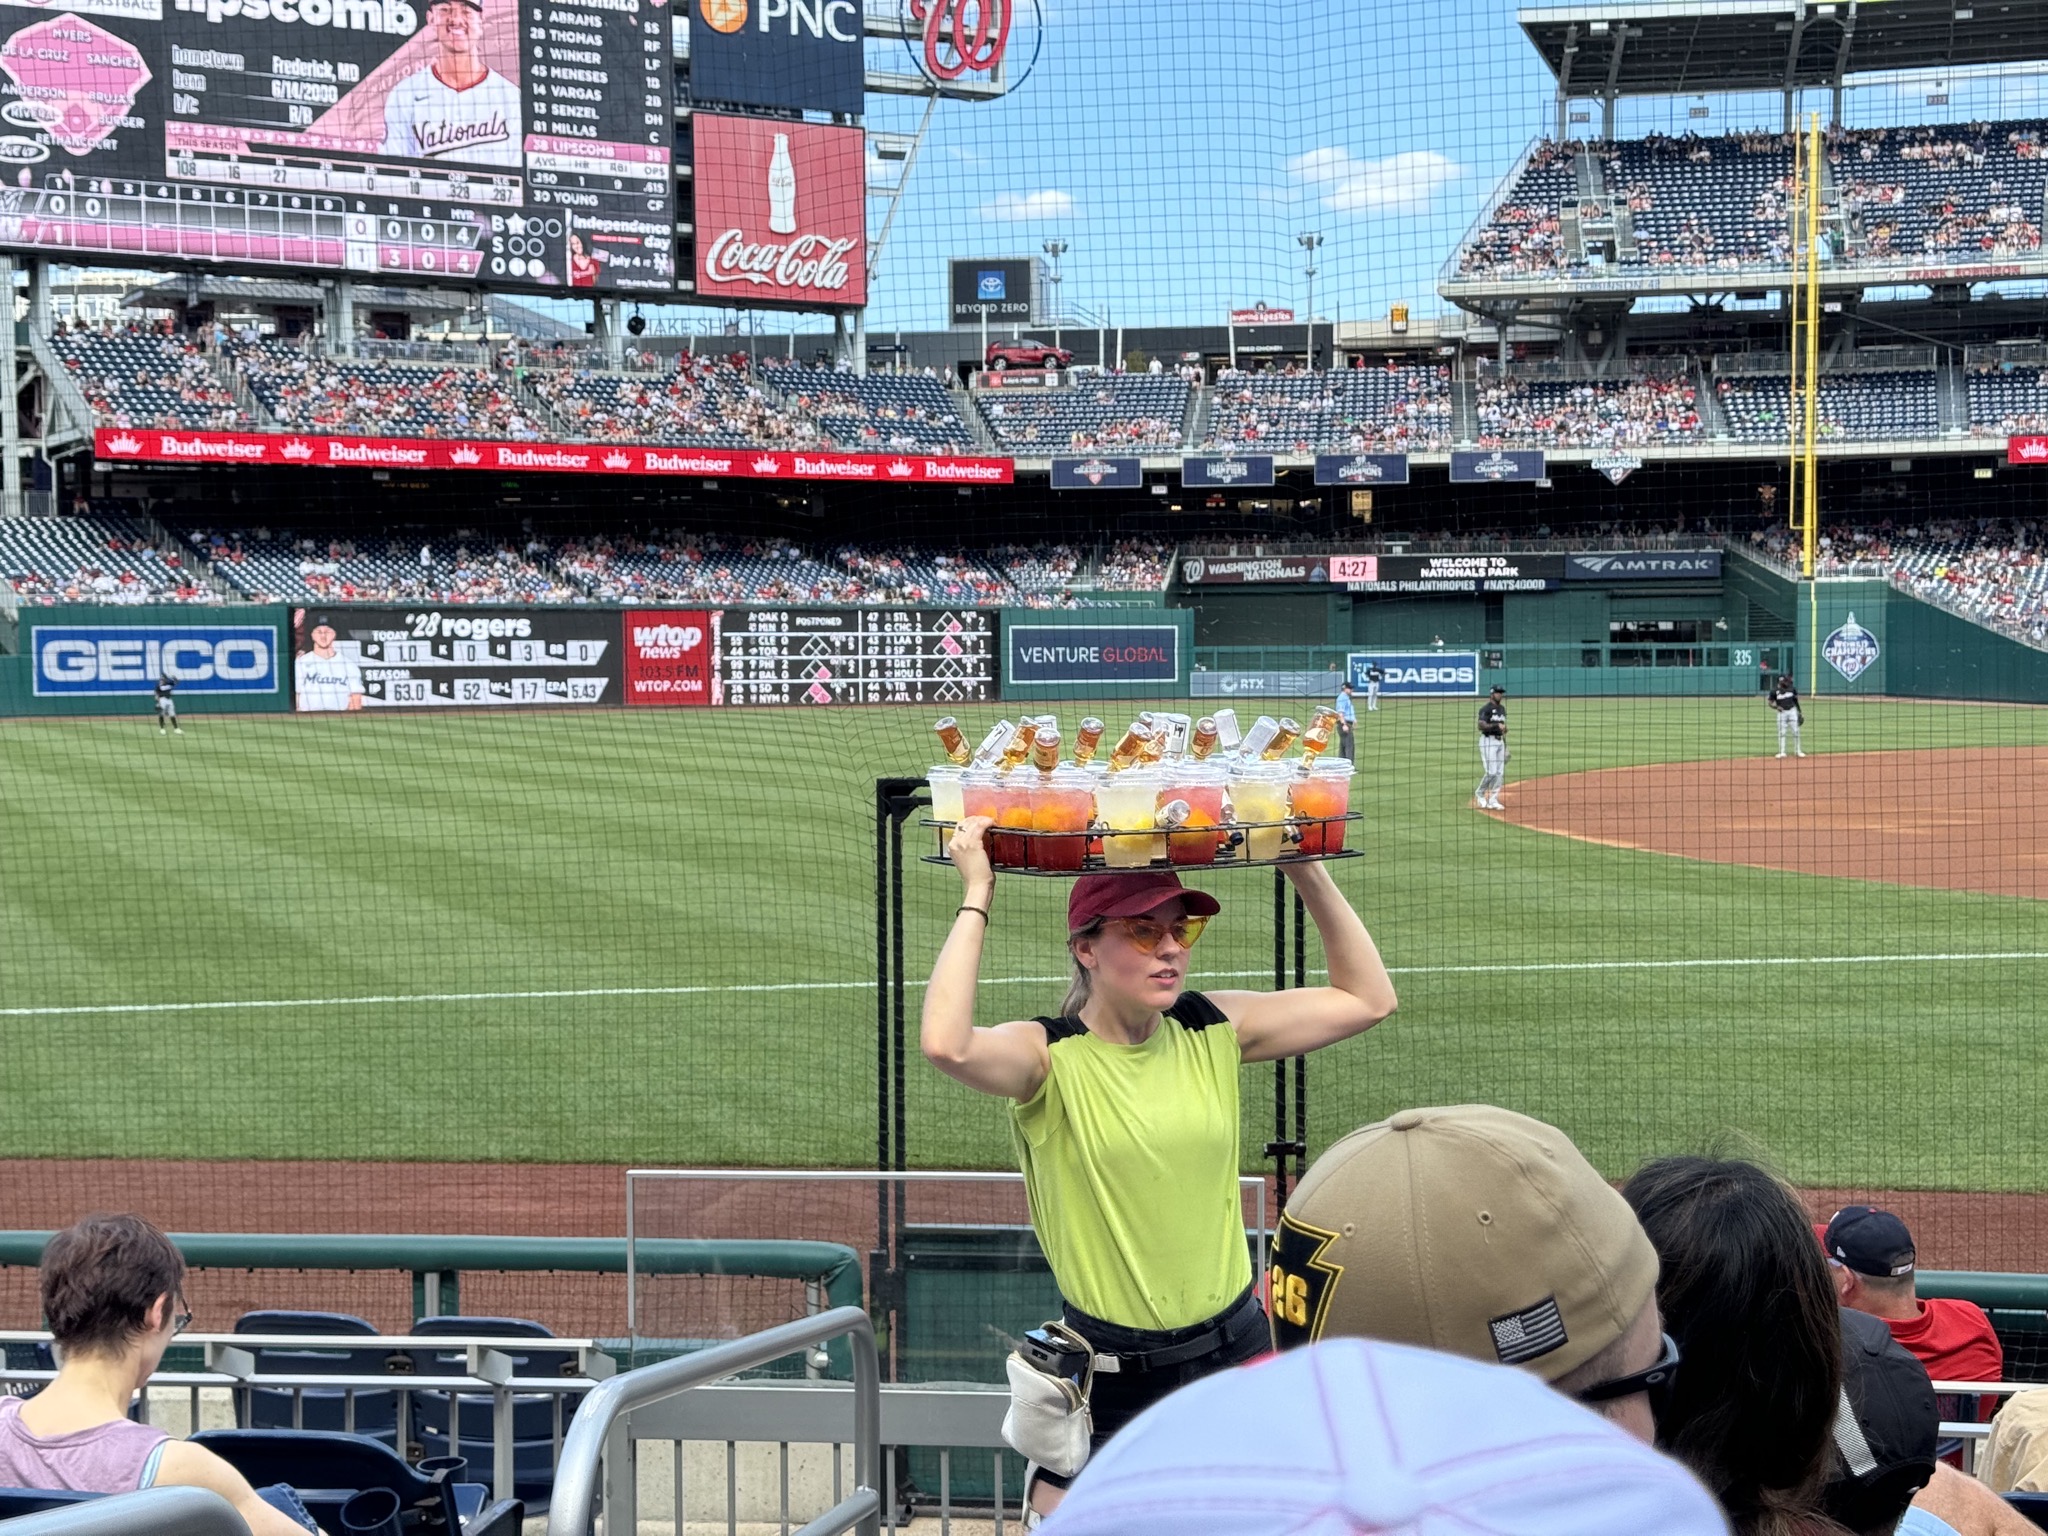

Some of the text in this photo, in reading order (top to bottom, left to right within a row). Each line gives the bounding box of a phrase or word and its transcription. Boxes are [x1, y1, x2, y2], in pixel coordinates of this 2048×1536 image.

[174, 0, 418, 37] pscomb
[549, 11, 660, 35] ABRAMS SS
[758, 0, 857, 42] PNC
[52, 29, 92, 43] MYERS
[530, 27, 661, 52] 28 THOMAS RF
[20, 47, 34, 58] LA
[38, 48, 70, 62] CRUZ
[86, 53, 140, 69] SANCHEZ
[533, 46, 661, 71] 6 WINKER LF
[172, 44, 244, 71] hometown
[272, 55, 336, 82] Frederick,
[337, 62, 360, 82] MD
[531, 64, 660, 89] 45 MENESES 1B
[1, 84, 66, 99] ANDERSON
[172, 69, 338, 104] born 6/14/2000
[533, 83, 662, 108] 14 VARGAS 2B
[533, 102, 663, 126] 13 SENZEL DH
[99, 115, 145, 129] BURGER
[412, 111, 510, 150] Nationals
[552, 122, 597, 138] MILLAS
[178, 138, 238, 150] THIS SEASON
[552, 140, 615, 157] LIPSCOMB
[534, 157, 665, 177] AVG HR RBI OPS
[177, 160, 197, 175] 108
[273, 170, 287, 184] 27
[410, 182, 420, 195] 10
[533, 190, 665, 211] 30 YOUNG CF
[50, 196, 470, 244] 0 0 0 0 4
[491, 215, 504, 232] B
[492, 236, 504, 254] S
[644, 235, 671, 251] day
[421, 251, 470, 271] 0 4
[1001, 302, 1029, 314] ZERO
[160, 436, 1003, 479] Budweiser Budweiser Budweiser Budweiser Budweiser Budweiser
[1208, 559, 1282, 575] WASHINGTON
[1338, 561, 1367, 578] 4:27
[1429, 557, 1506, 568] WELCOME TO
[1610, 559, 1708, 571] AMTRAK
[1243, 566, 1305, 581] NATIONALS
[1421, 567, 1519, 577] NATIONALS PARK
[1347, 579, 1546, 591] NATIONALS PHILANTHROPIES #NATS4GOOD
[758, 612, 779, 621] OAK
[796, 617, 842, 626] POSTPONED
[867, 612, 909, 621] 47 STL
[442, 618, 532, 640] rogers
[758, 623, 776, 632] MIN
[893, 623, 912, 632] CHC
[372, 630, 408, 641] TODAY
[633, 624, 702, 651] wtop
[758, 637, 776, 645] CLE
[894, 635, 912, 645] LAA
[367, 644, 379, 655] IP
[640, 646, 681, 659] news
[758, 647, 778, 656] TOR
[893, 646, 905, 655] SF
[1020, 646, 1168, 663] VENTURE GLOBAL
[42, 639, 270, 682] GEICO
[759, 660, 775, 669] PHI
[894, 659, 911, 668] DET
[1734, 649, 1751, 666] 335
[366, 670, 410, 681] SEASON
[639, 665, 698, 678] 103.5 FM
[759, 671, 778, 680] BAL
[868, 669, 914, 678] 41 HOU
[1385, 667, 1473, 683] DABOS
[369, 684, 380, 694] IP
[394, 684, 424, 701] 63.0
[463, 683, 480, 700] 52
[521, 683, 537, 699] 1-7
[546, 682, 567, 692] ERA
[572, 684, 596, 699] 5.43
[634, 680, 702, 692] WTOP.COM
[759, 684, 772, 693] SD
[894, 682, 906, 691] TB
[1241, 679, 1264, 689] RTX
[759, 695, 780, 704] NYM
[894, 692, 911, 702] ATL
[1272, 1264, 1308, 1327] 26
